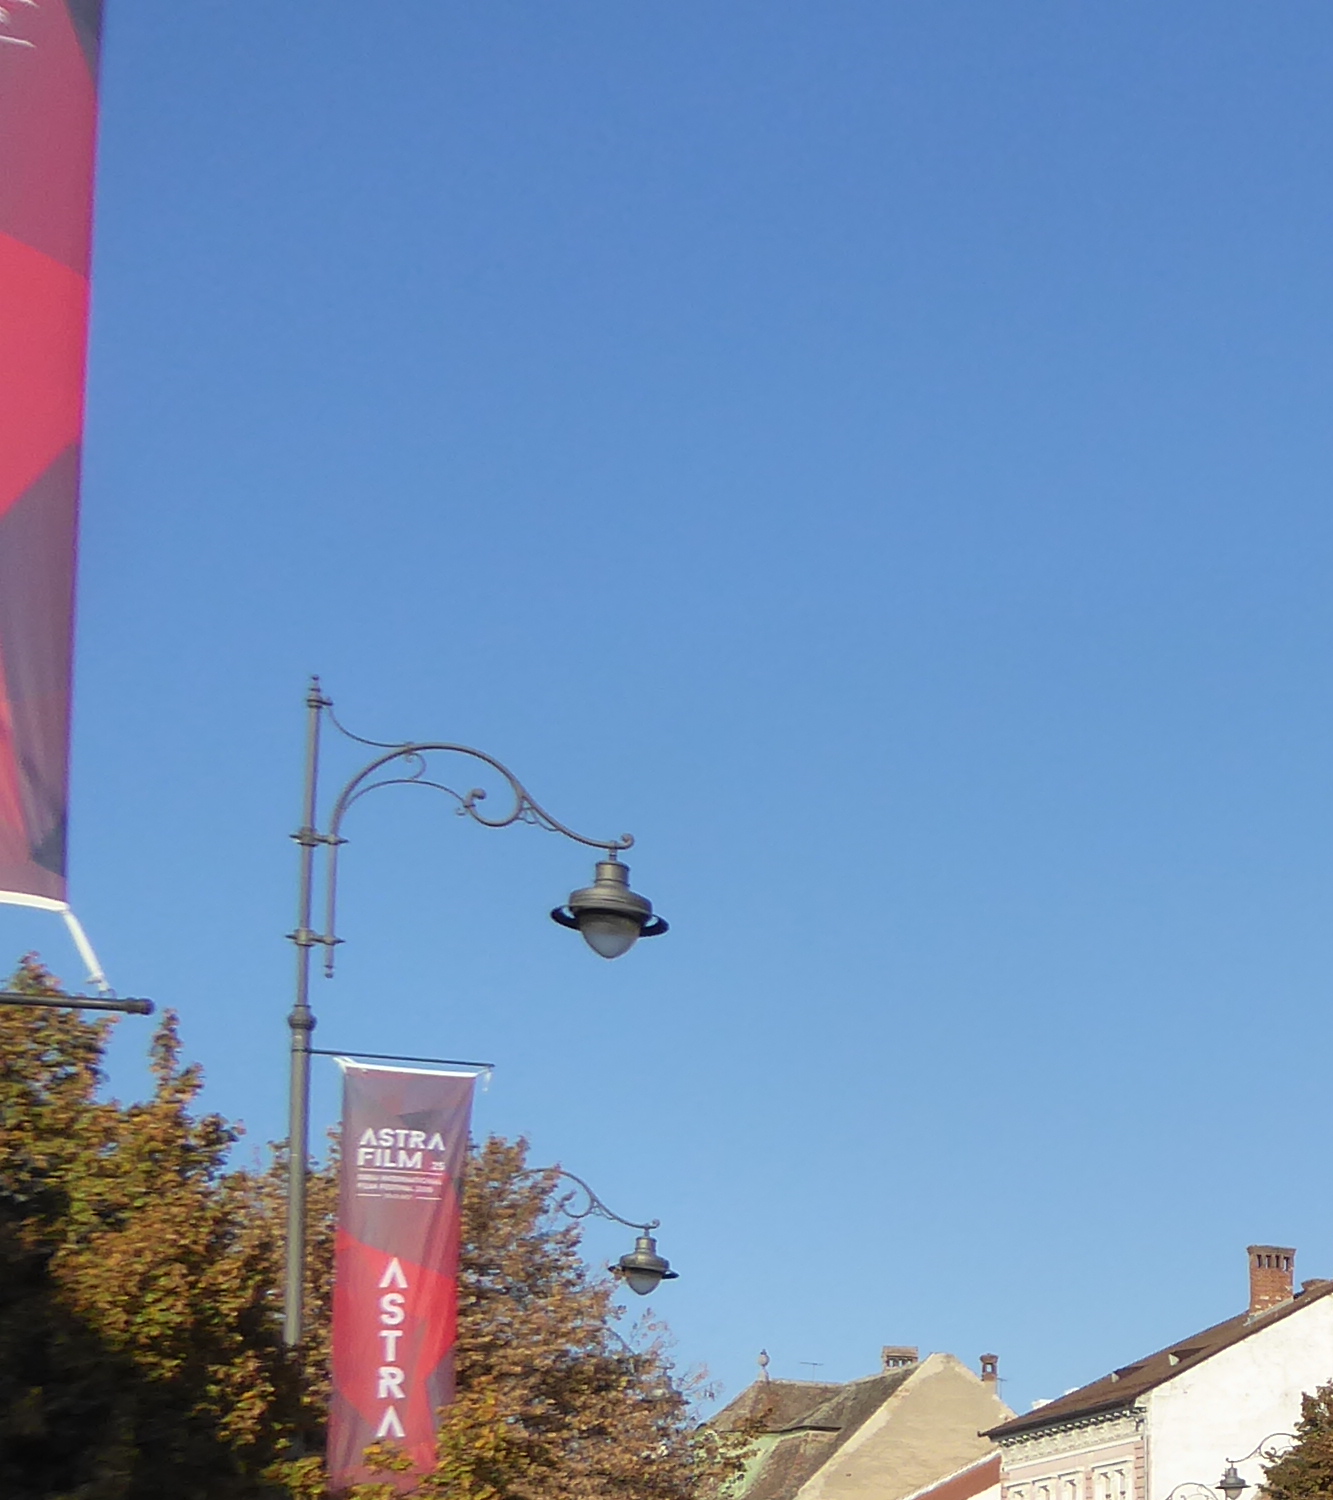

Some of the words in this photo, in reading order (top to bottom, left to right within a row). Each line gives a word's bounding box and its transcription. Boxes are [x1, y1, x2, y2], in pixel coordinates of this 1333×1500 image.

[360, 1128, 446, 1151] ASTRA
[357, 1147, 422, 1169] FILM
[376, 1256, 408, 1437] ASTRA
